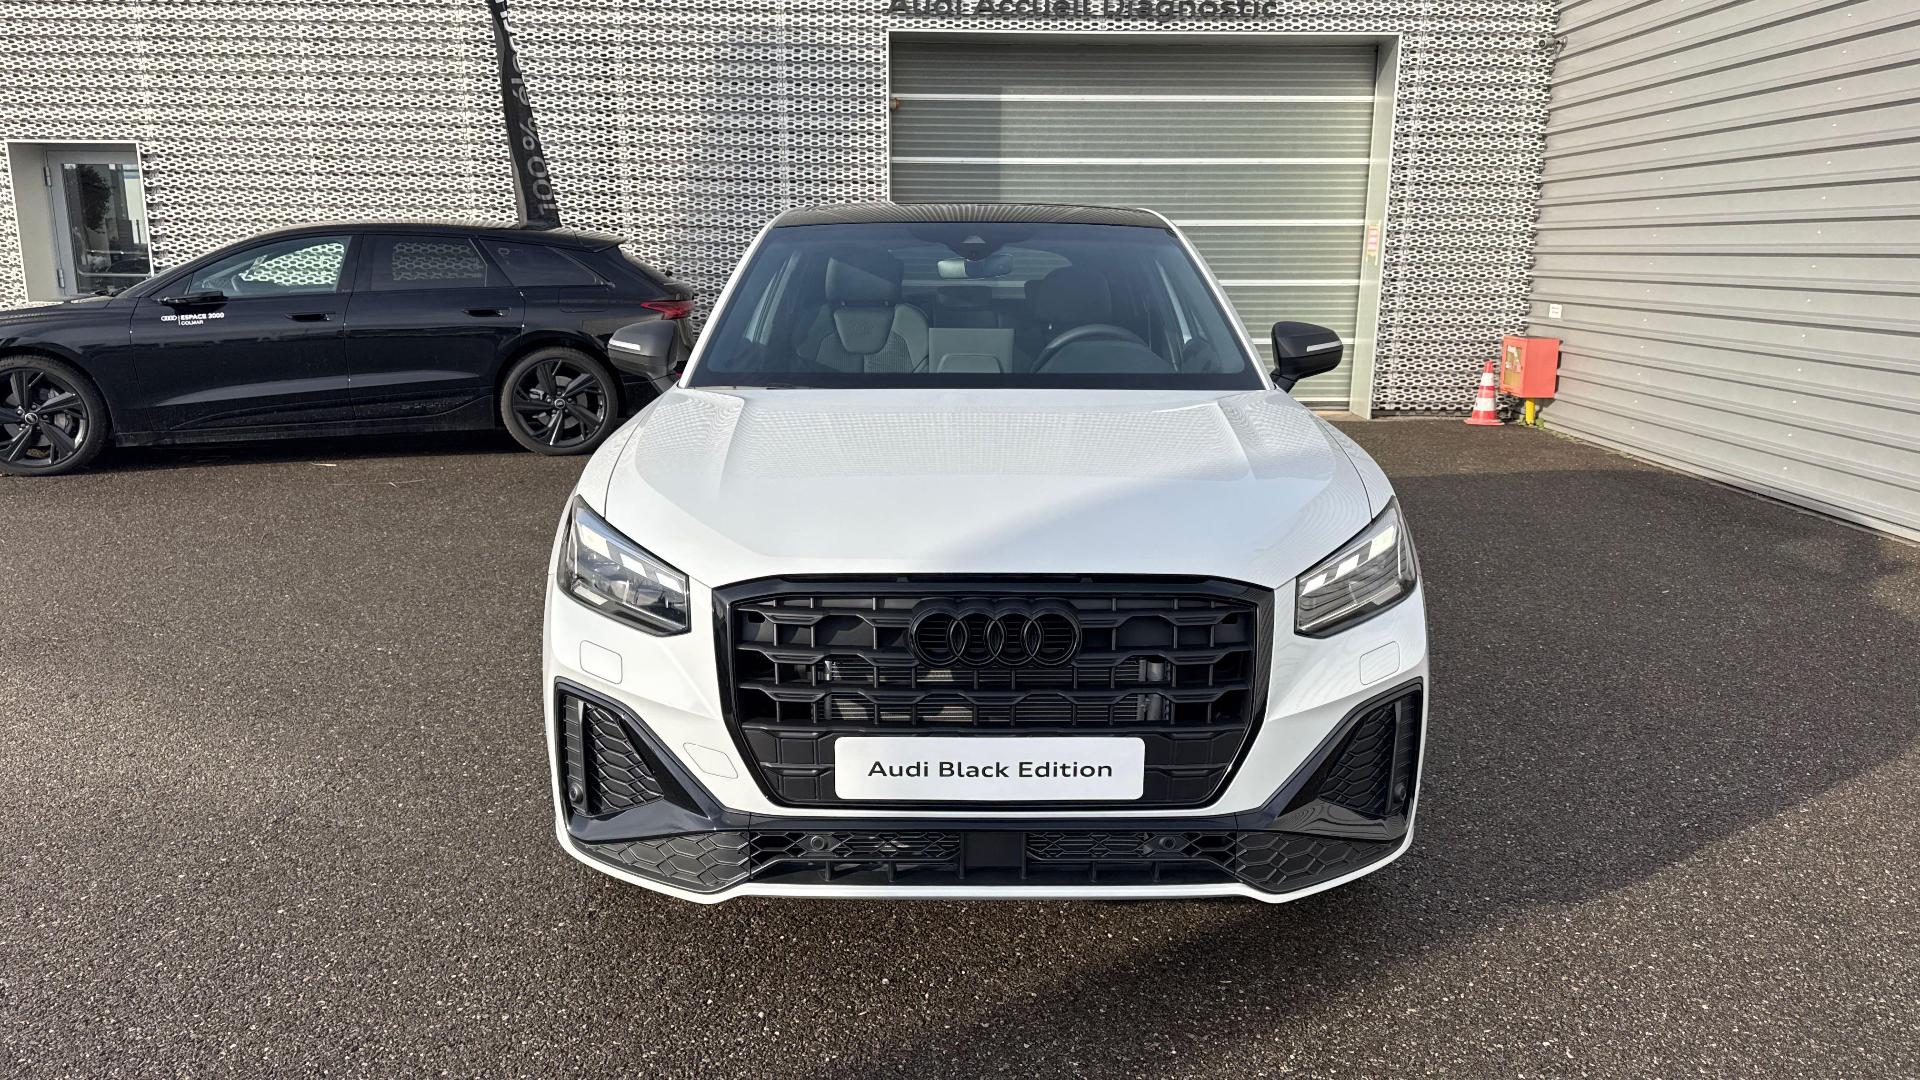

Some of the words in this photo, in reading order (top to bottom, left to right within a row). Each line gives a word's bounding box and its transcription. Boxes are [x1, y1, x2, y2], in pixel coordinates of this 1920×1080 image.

[887, 0, 961, 15] Audi
[972, 0, 1091, 16] Accueil
[1102, 0, 1278, 22] Diagnostic
[867, 761, 929, 778] Audi
[939, 761, 1010, 778] Black
[1018, 761, 1113, 778] Edition
